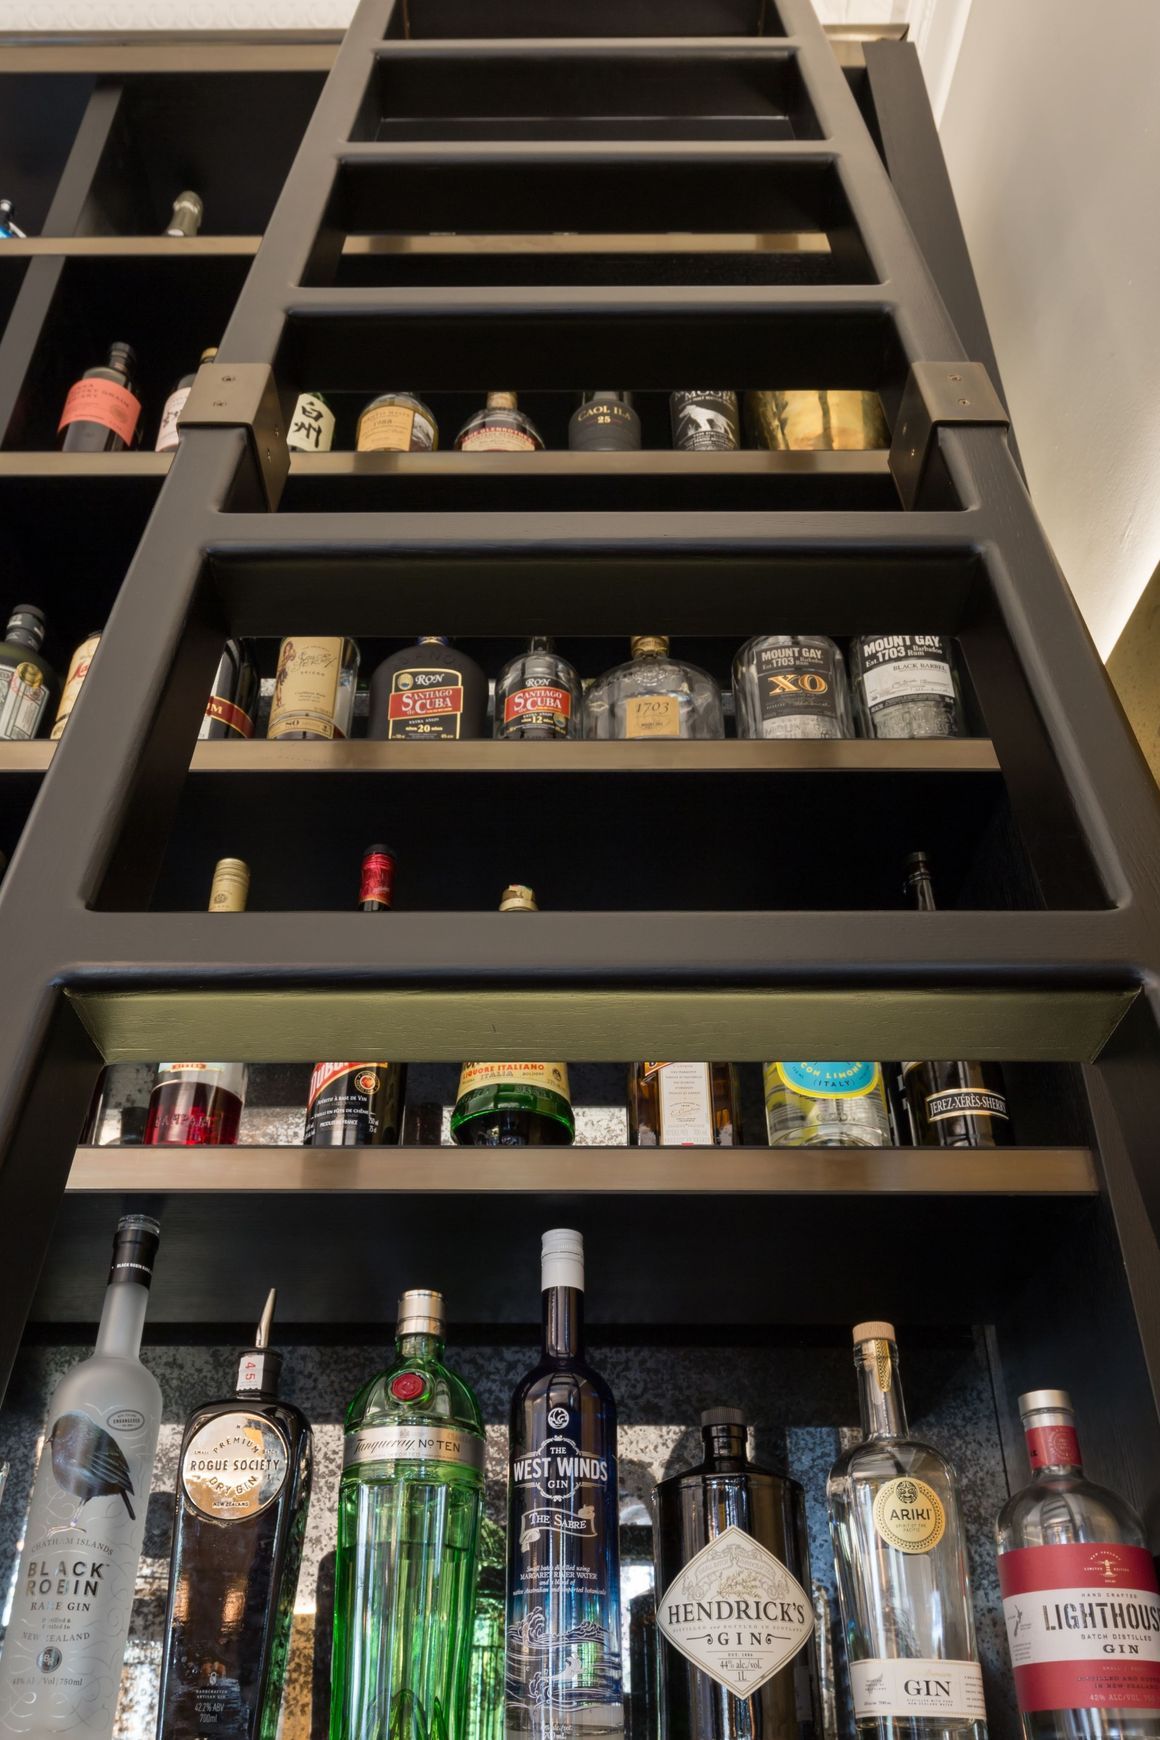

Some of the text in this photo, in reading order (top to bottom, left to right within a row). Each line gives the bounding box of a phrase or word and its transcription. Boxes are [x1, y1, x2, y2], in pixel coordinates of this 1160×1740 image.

[578, 405, 611, 421] CAOL
[597, 415, 612, 425] 25
[294, 401, 324, 449] 白州
[863, 635, 941, 658] MOUNT GAY
[876, 646, 906, 663] 1703
[907, 649, 925, 657] Rum
[761, 648, 823, 662] MOUNT GAY
[772, 657, 795, 668] 1703
[414, 673, 446, 686] RON
[525, 678, 551, 688] RON
[767, 674, 828, 697] XO
[401, 688, 453, 712] SANTIAGO
[414, 697, 452, 714] CUBA
[513, 689, 562, 712] SANTIAGO
[525, 697, 562, 711] CUBA
[531, 715, 543, 724] 12
[417, 724, 431, 733] 20
[462, 1063, 546, 1080] LIQUORE ITALIANO
[800, 1062, 821, 1077] CON
[212, 1437, 260, 1454] PREMIUM
[352, 1438, 416, 1457] Tanqueray
[436, 1439, 461, 1453] TEN
[549, 1446, 567, 1455] THE
[190, 1459, 280, 1472] ROGUE SOCIETY
[513, 1456, 609, 1482] WEST WINDS
[208, 1475, 258, 1496] DRY GIN
[547, 1480, 569, 1489] GIN
[528, 1513, 587, 1530] THE SABRE
[889, 1508, 931, 1521] ARIKI
[76, 1538, 115, 1557] ISLANDS
[27, 1561, 105, 1580] BLACK
[576, 1571, 598, 1580] WATER
[30, 1601, 92, 1613] RAE GIN
[667, 1599, 806, 1625] HENDRICK'S
[1042, 1602, 1160, 1633] LIGHTHOUS
[717, 1632, 762, 1646] GIN
[1102, 1643, 1140, 1655] GIN
[903, 1679, 952, 1698] GIN
